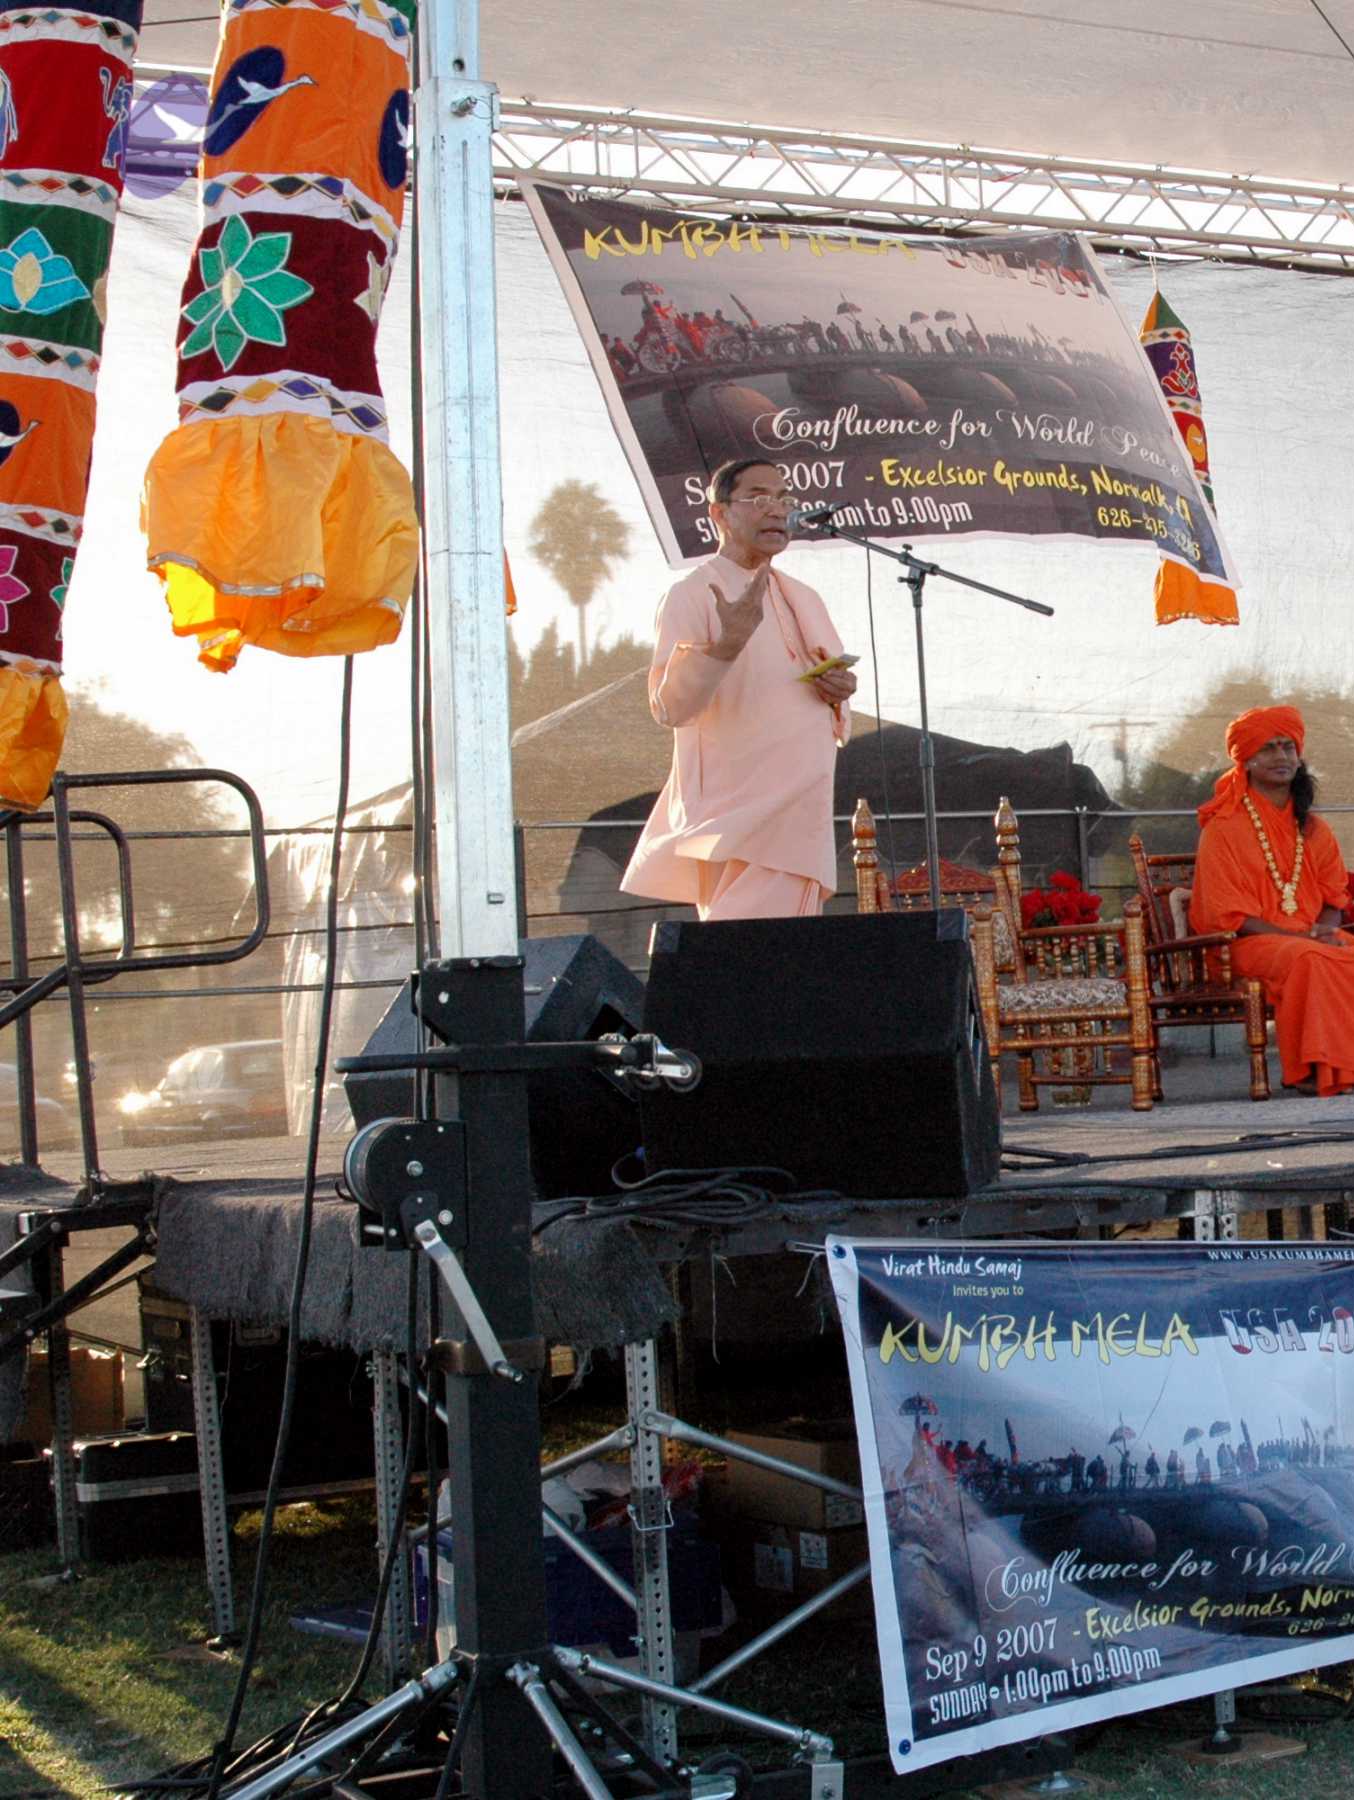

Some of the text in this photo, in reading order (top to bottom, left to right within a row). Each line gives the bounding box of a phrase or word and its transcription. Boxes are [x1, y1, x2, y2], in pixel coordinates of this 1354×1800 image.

[584, 219, 764, 260] KUMBH
[753, 404, 940, 451] Confluence
[940, 408, 992, 449] for
[996, 409, 1095, 447] World
[881, 458, 987, 489] Excelsior
[993, 459, 1088, 496] Grounds,
[864, 499, 888, 526] to
[893, 497, 973, 531] 9:00pm
[882, 1254, 1023, 1281] Virat Hindu Samaj
[953, 1284, 1024, 1299] Invites you to
[879, 1311, 1199, 1372] KUMBH MELA
[1218, 1308, 1306, 1355] USA
[985, 1549, 1159, 1612] Confluence
[1148, 1549, 1218, 1590] for
[1231, 1542, 1346, 1577] World
[926, 1646, 968, 1682] Sep
[974, 1634, 987, 1668] 9
[997, 1617, 1057, 1663] 2007
[1085, 1600, 1183, 1640] Excelsior
[1189, 1596, 1292, 1627] Grounds,
[930, 1645, 1161, 1725] SUNDAY 1:00pm to 9:00pm
